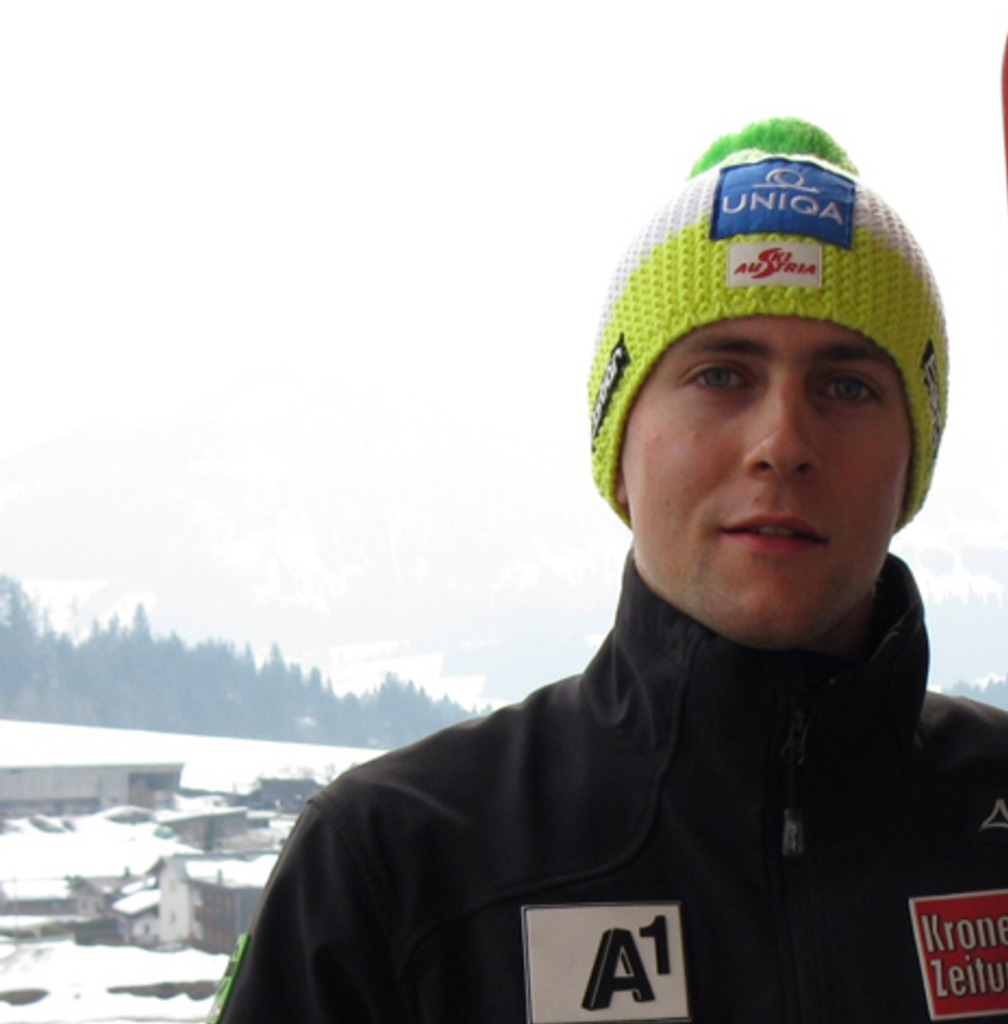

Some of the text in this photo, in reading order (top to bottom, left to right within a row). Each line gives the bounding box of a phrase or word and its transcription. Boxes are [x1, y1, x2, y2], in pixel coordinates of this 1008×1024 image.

[722, 191, 844, 225] UNIQA
[733, 261, 816, 280] AUSTRIA
[581, 915, 671, 1012] A1
